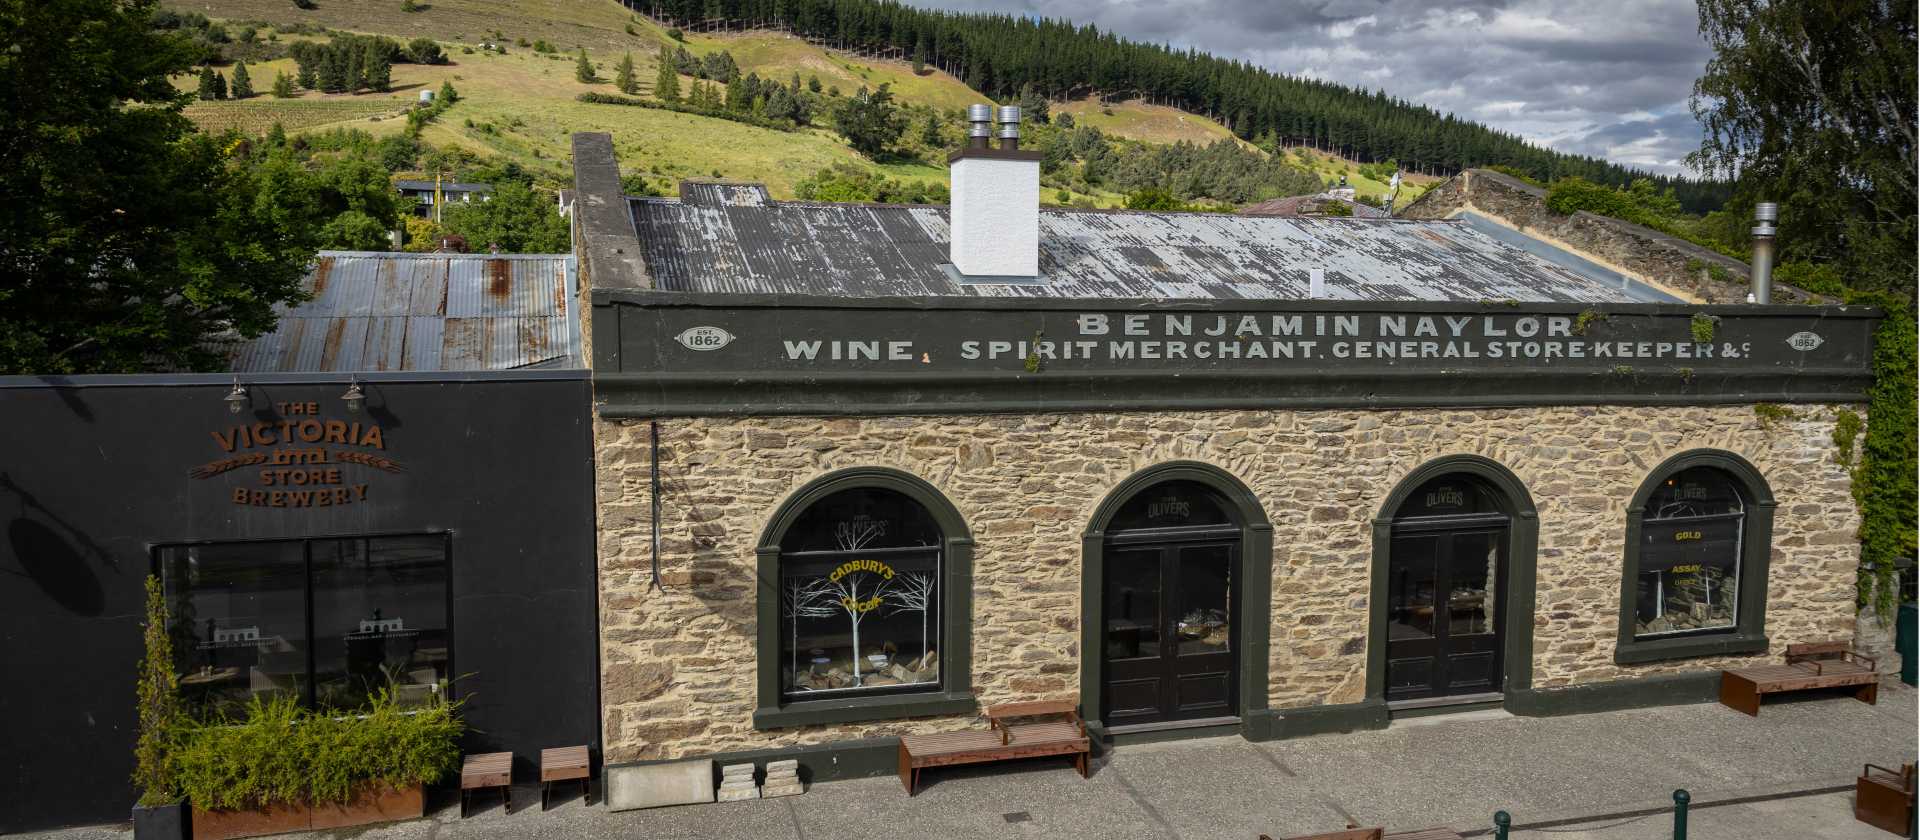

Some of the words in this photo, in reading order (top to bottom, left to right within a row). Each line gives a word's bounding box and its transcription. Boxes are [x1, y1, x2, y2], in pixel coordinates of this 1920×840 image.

[1079, 314, 1360, 337] BENJAMIN
[1379, 315, 1572, 338] NAYLOR
[690, 336, 721, 345] 1862
[960, 340, 1098, 360] SPIRIT
[1332, 341, 1480, 358] GENERAL
[278, 401, 319, 415] THE
[210, 420, 384, 451] VICTORIA
[260, 469, 341, 484] STORE
[232, 484, 368, 508] BREWERY
[1675, 531, 1702, 541] GOLD
[829, 559, 896, 582] CADBURY'S
[1672, 564, 1701, 574] ASSAY
